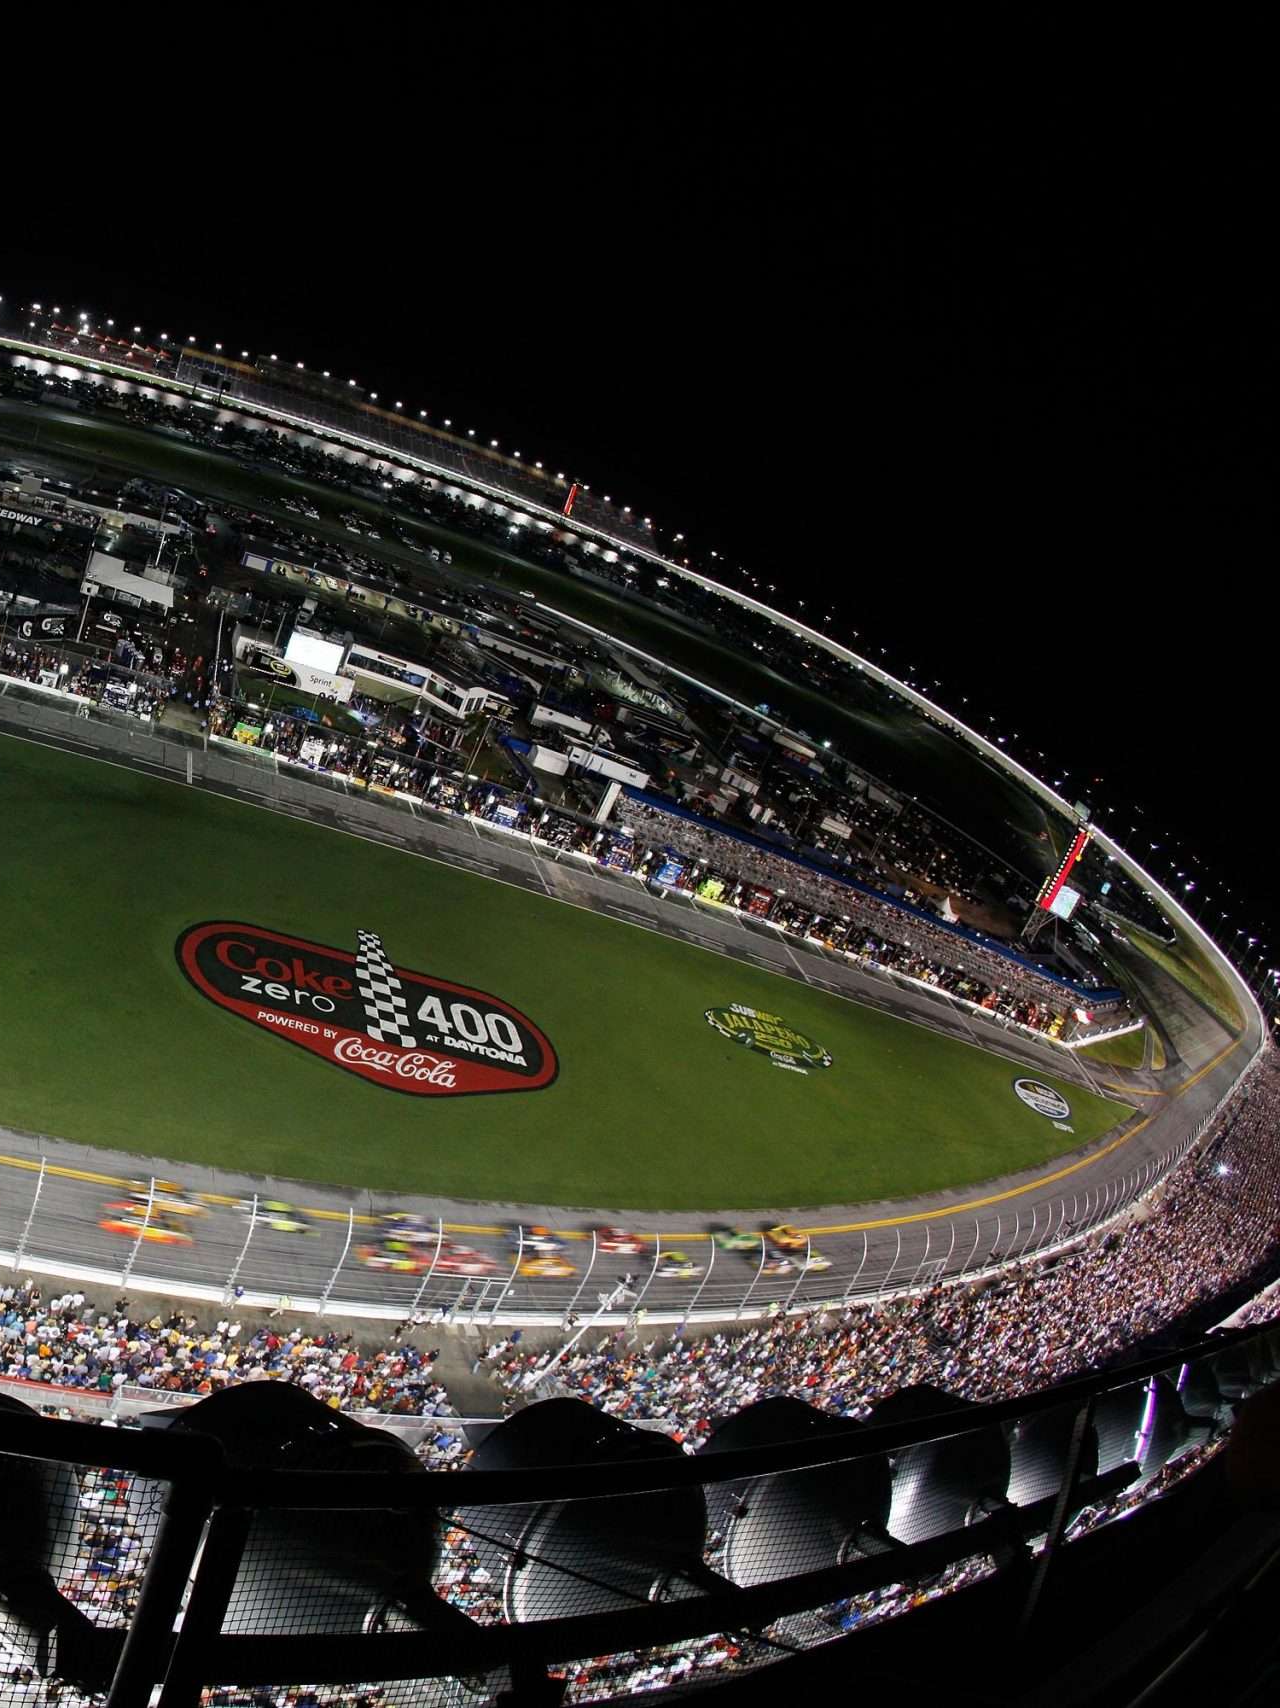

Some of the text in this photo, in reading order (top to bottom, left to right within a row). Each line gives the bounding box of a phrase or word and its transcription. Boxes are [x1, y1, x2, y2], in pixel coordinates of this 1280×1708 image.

[22, 621, 32, 637] G
[310, 675, 332, 688] Sprint
[215, 939, 357, 1000] Coke
[239, 974, 336, 1013] zero
[257, 1010, 338, 1040] POWERED BY
[416, 995, 523, 1053] 400
[729, 1002, 783, 1025] SUBWAY
[334, 1036, 457, 1088] Coca-Cola
[425, 1034, 528, 1068] AT DAYTONA
